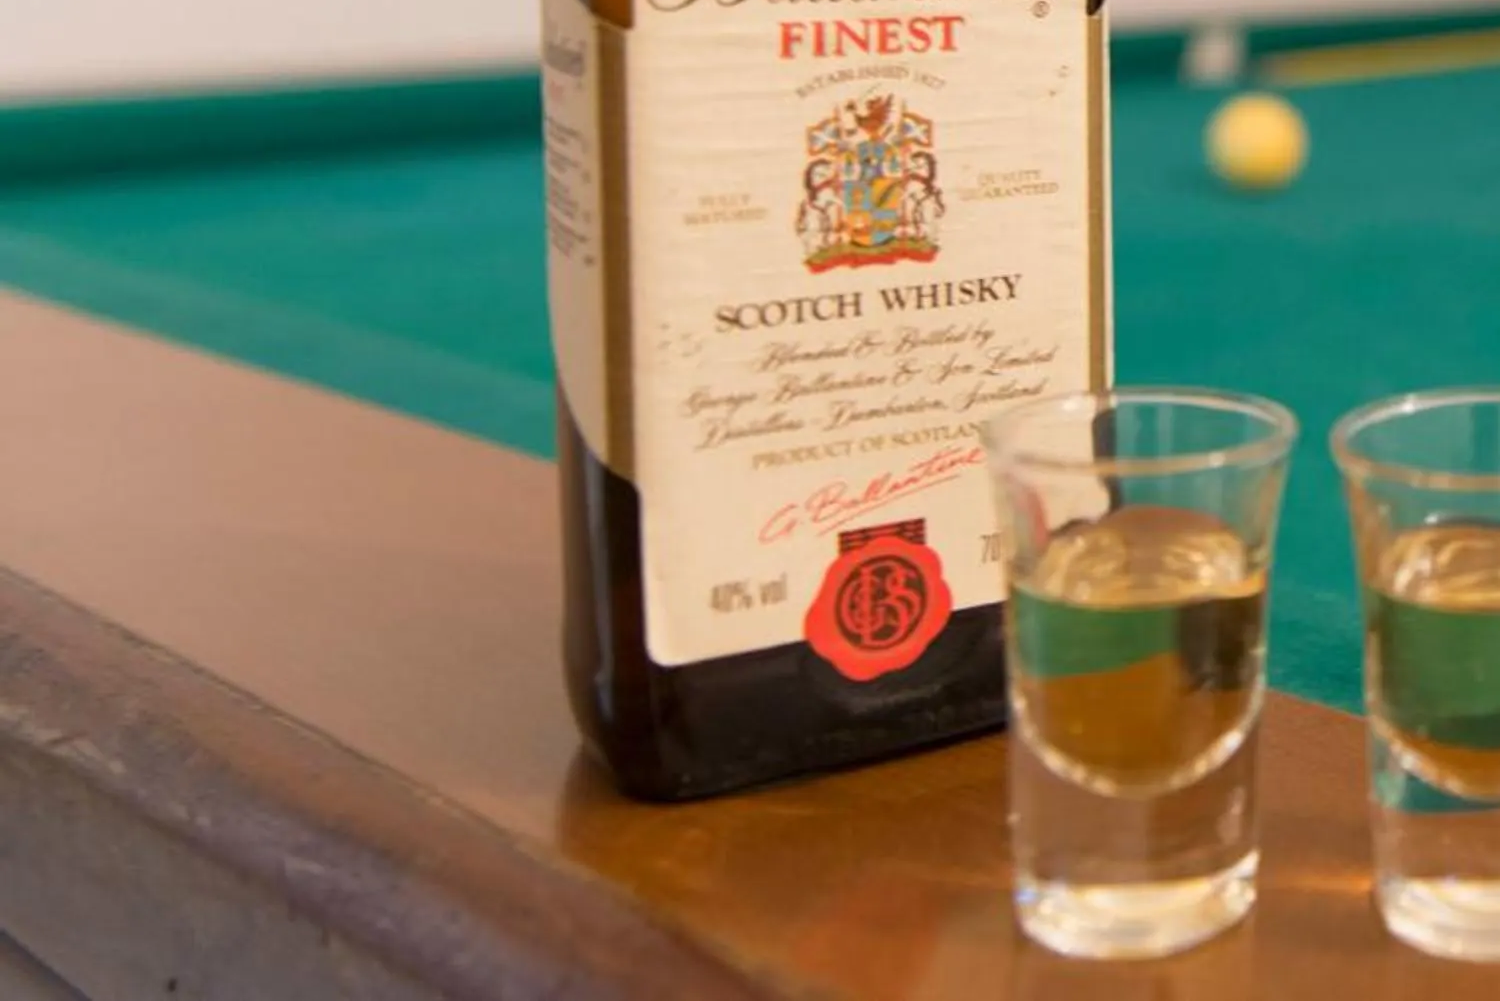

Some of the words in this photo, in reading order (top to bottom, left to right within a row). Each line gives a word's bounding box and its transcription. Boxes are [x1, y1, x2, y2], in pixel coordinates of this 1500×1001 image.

[778, 16, 967, 59] FINEST
[714, 291, 863, 333] SCOTCH
[879, 274, 1023, 311] WHISKY
[890, 419, 990, 446] SCOTLAN
